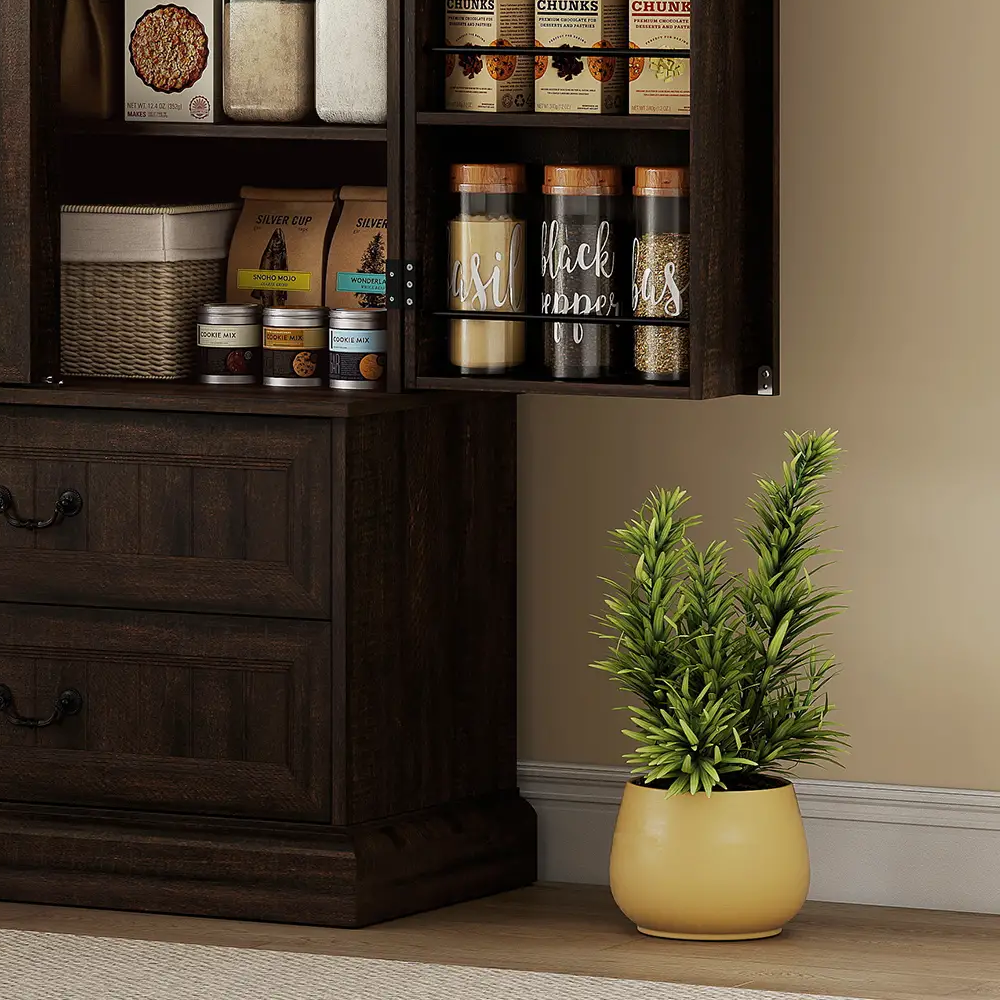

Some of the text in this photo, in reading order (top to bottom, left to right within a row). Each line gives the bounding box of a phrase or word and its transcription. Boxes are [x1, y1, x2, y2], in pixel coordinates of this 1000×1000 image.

[447, 0, 494, 10] CHUNKS
[537, 0, 599, 11] CHUNKS
[631, 0, 690, 12] CHUNK
[256, 214, 313, 226] SILVER CUP
[356, 217, 388, 228] SILVER
[448, 223, 523, 312] asil
[541, 291, 620, 345] epper
